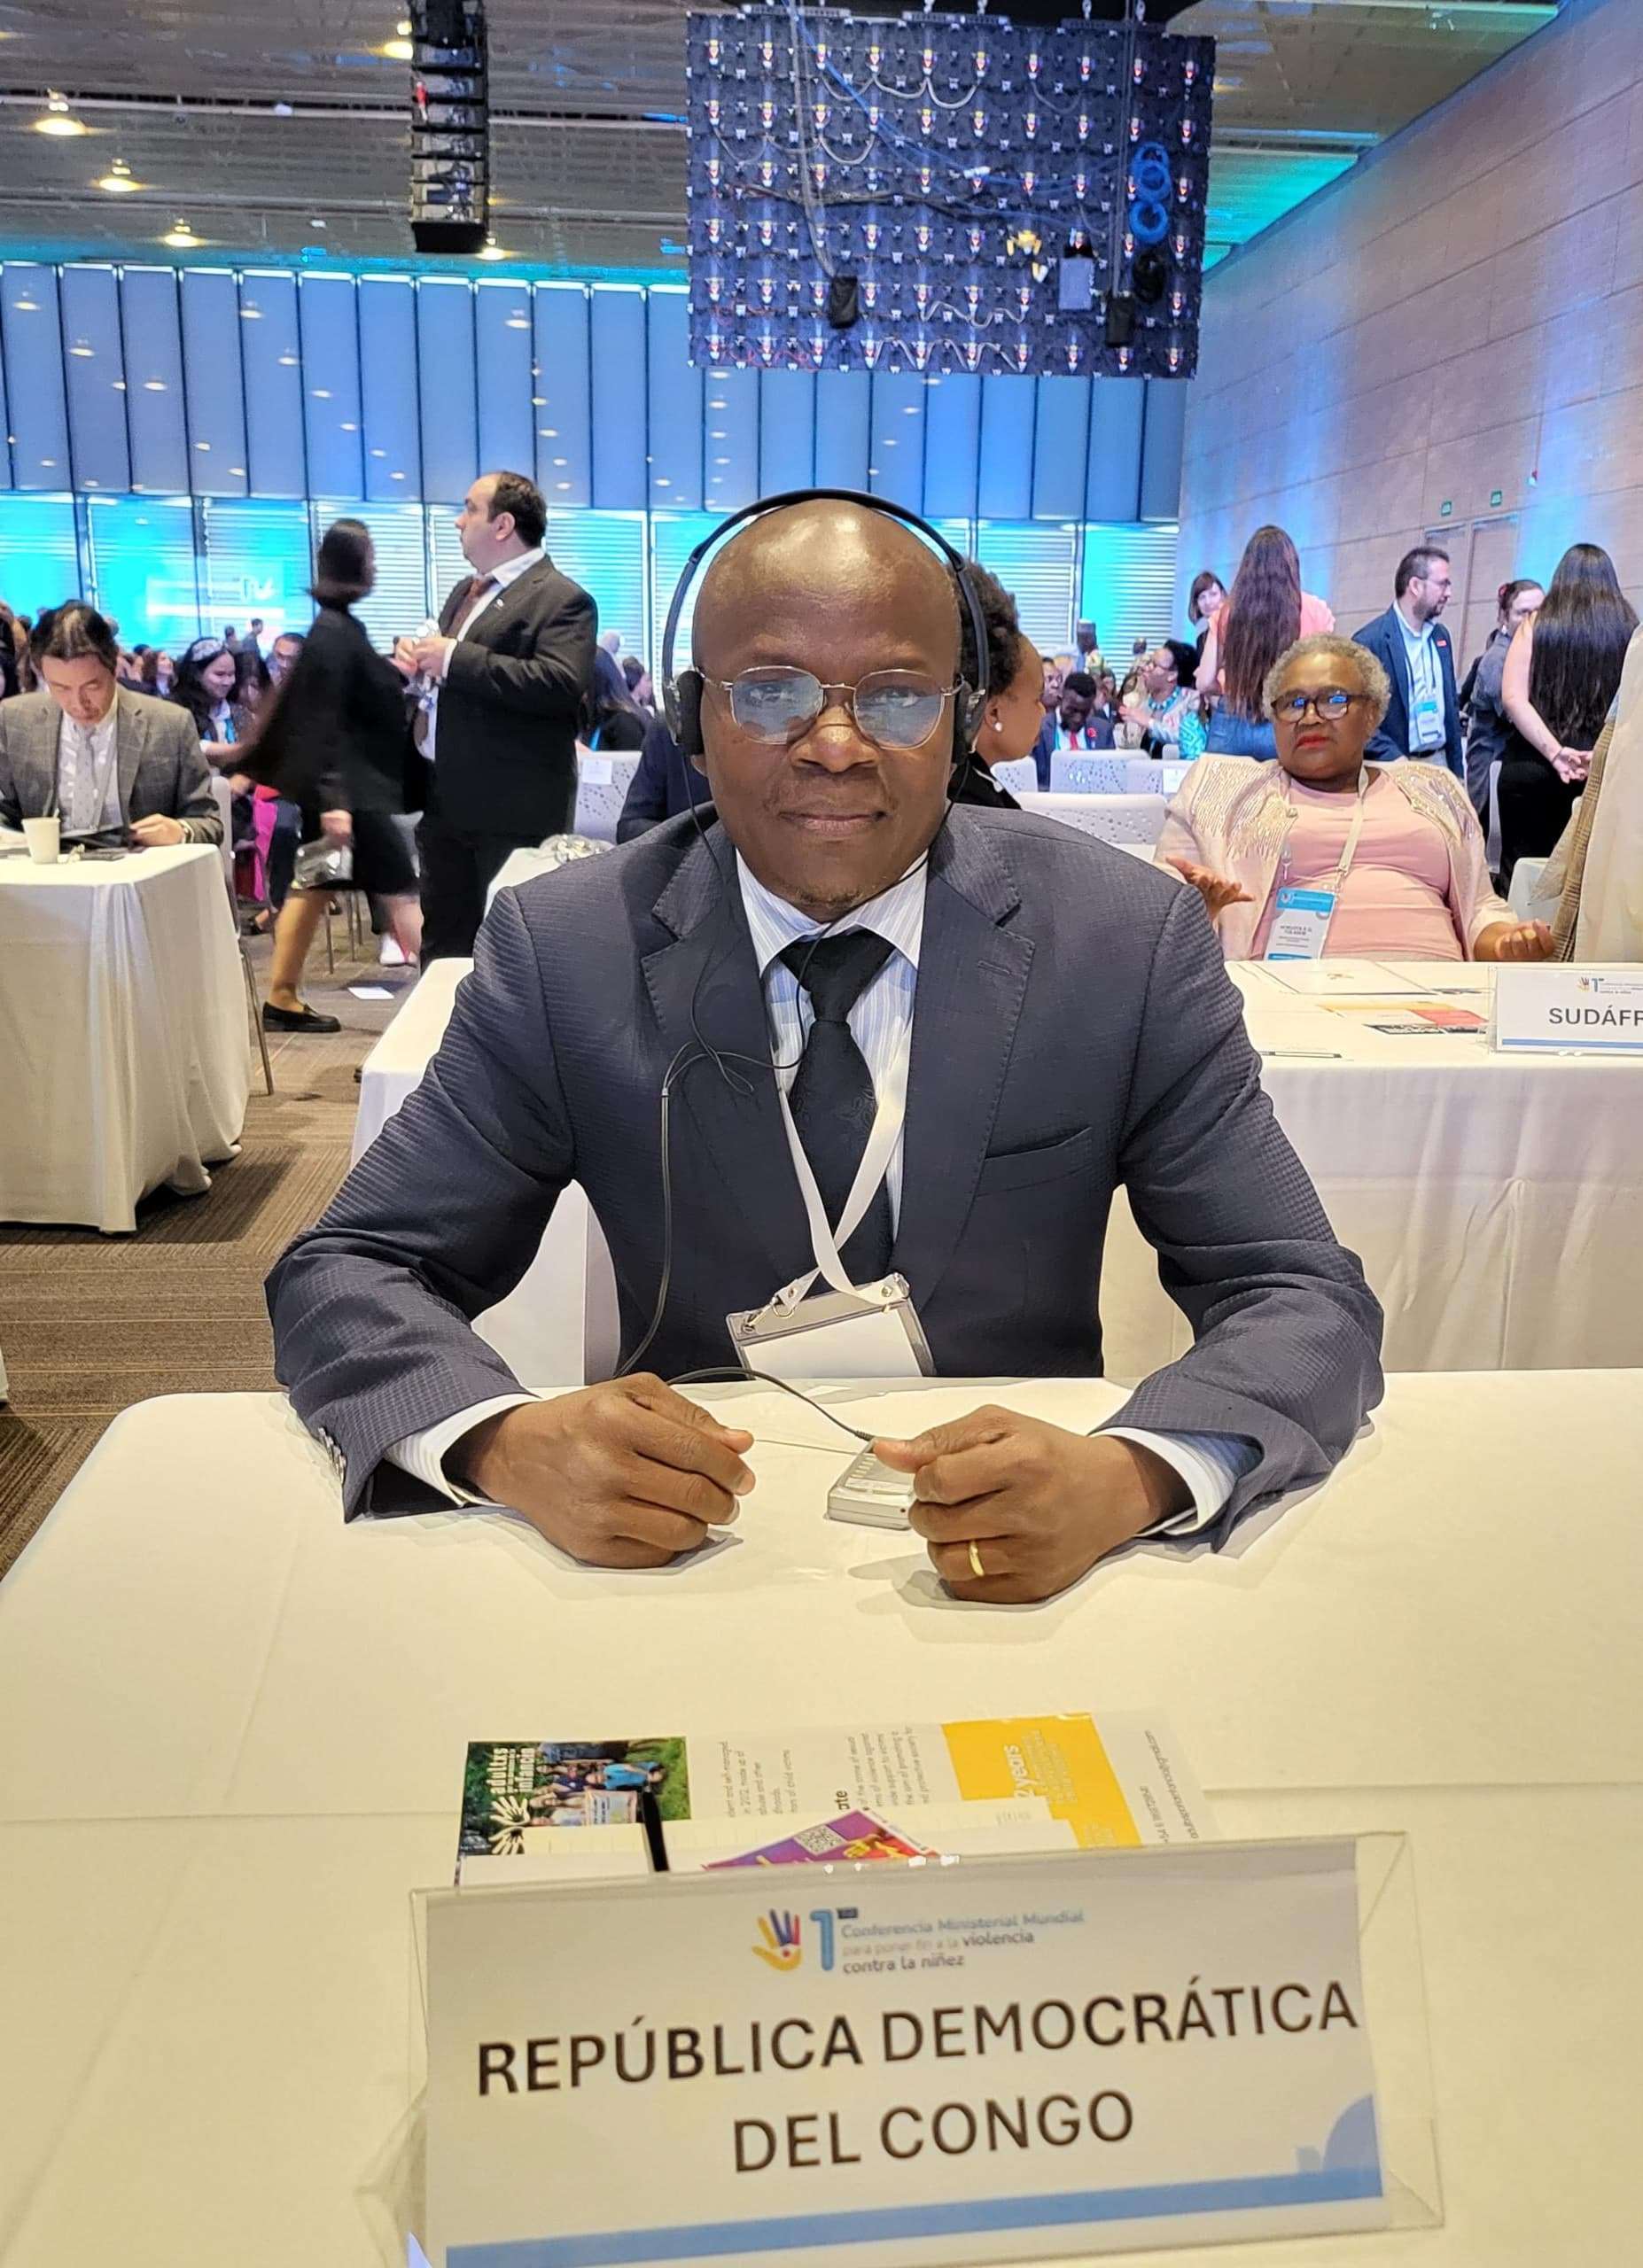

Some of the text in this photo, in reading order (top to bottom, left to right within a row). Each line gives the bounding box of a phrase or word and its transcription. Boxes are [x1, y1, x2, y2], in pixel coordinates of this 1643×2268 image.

[1003, 1743, 1040, 1787] years
[835, 1790, 851, 1810] ate
[842, 1921, 933, 1938] Conferencia
[938, 1915, 1018, 1930] Ministerial
[1023, 1908, 1084, 1924] Mundial
[962, 1929, 1034, 1946] violencia
[843, 1953, 964, 1974] contra la niñez
[478, 1977, 1360, 2096] REPÚBLICA DEMOCRÁTICA
[734, 2090, 1134, 2172] DEL CONGO
